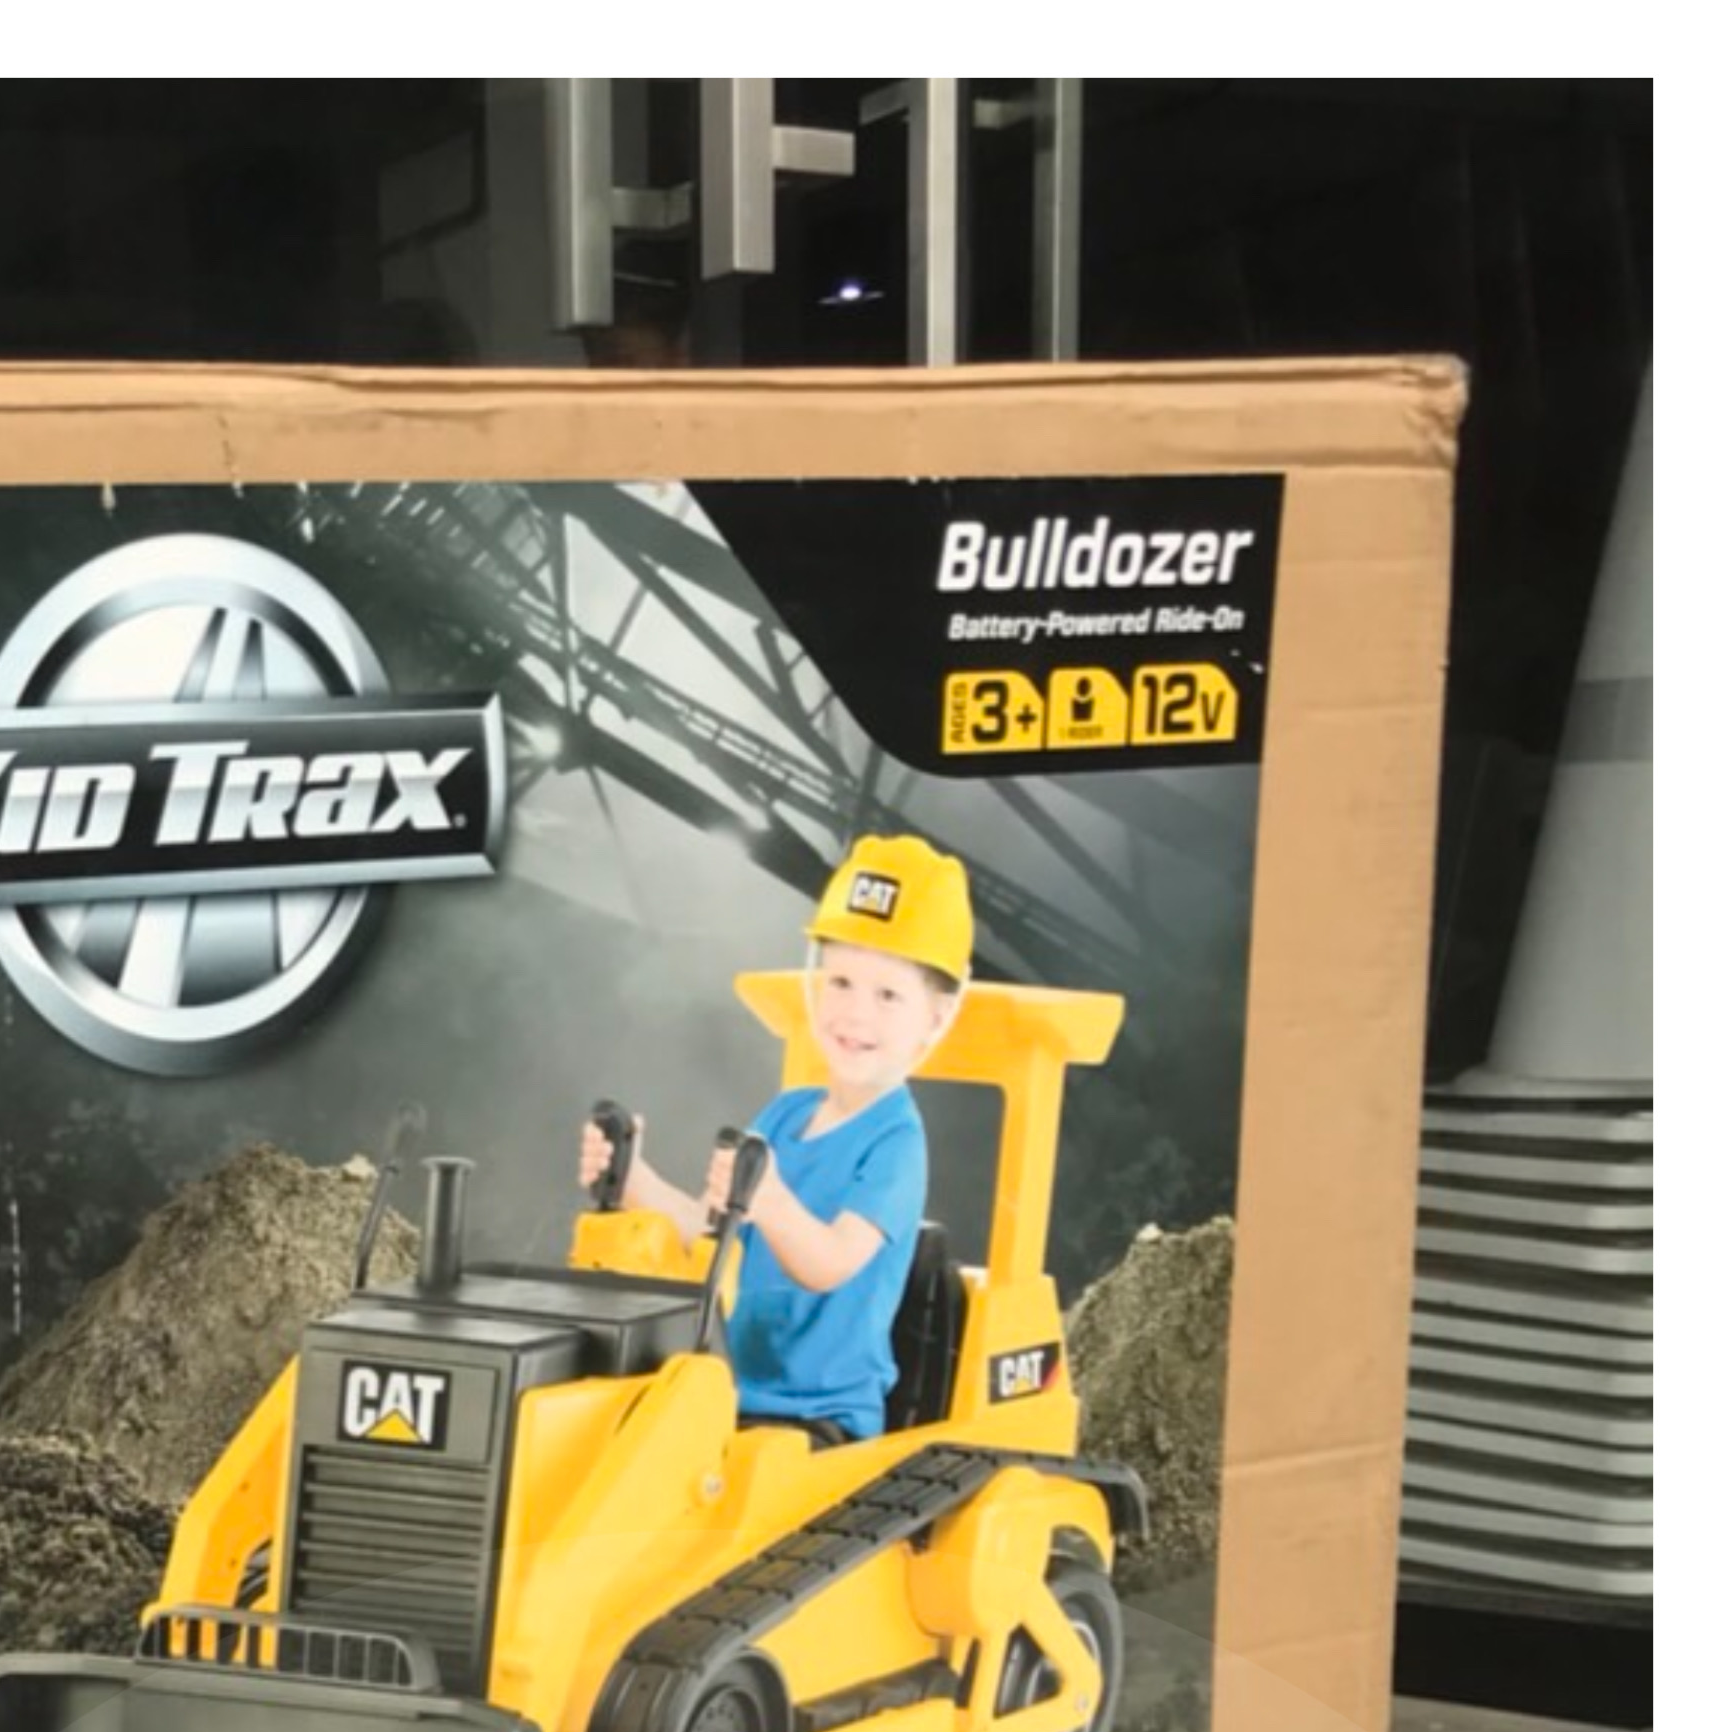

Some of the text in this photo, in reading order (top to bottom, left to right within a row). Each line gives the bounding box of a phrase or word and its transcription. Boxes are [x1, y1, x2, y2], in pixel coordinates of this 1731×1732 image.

[937, 516, 1253, 591] Bulldozer
[948, 604, 1246, 645] Battery-Powered Ride-On
[971, 679, 1037, 744] 3+
[852, 876, 896, 914] CAT
[999, 1350, 1045, 1397] CAT
[344, 1366, 445, 1445] CAT
